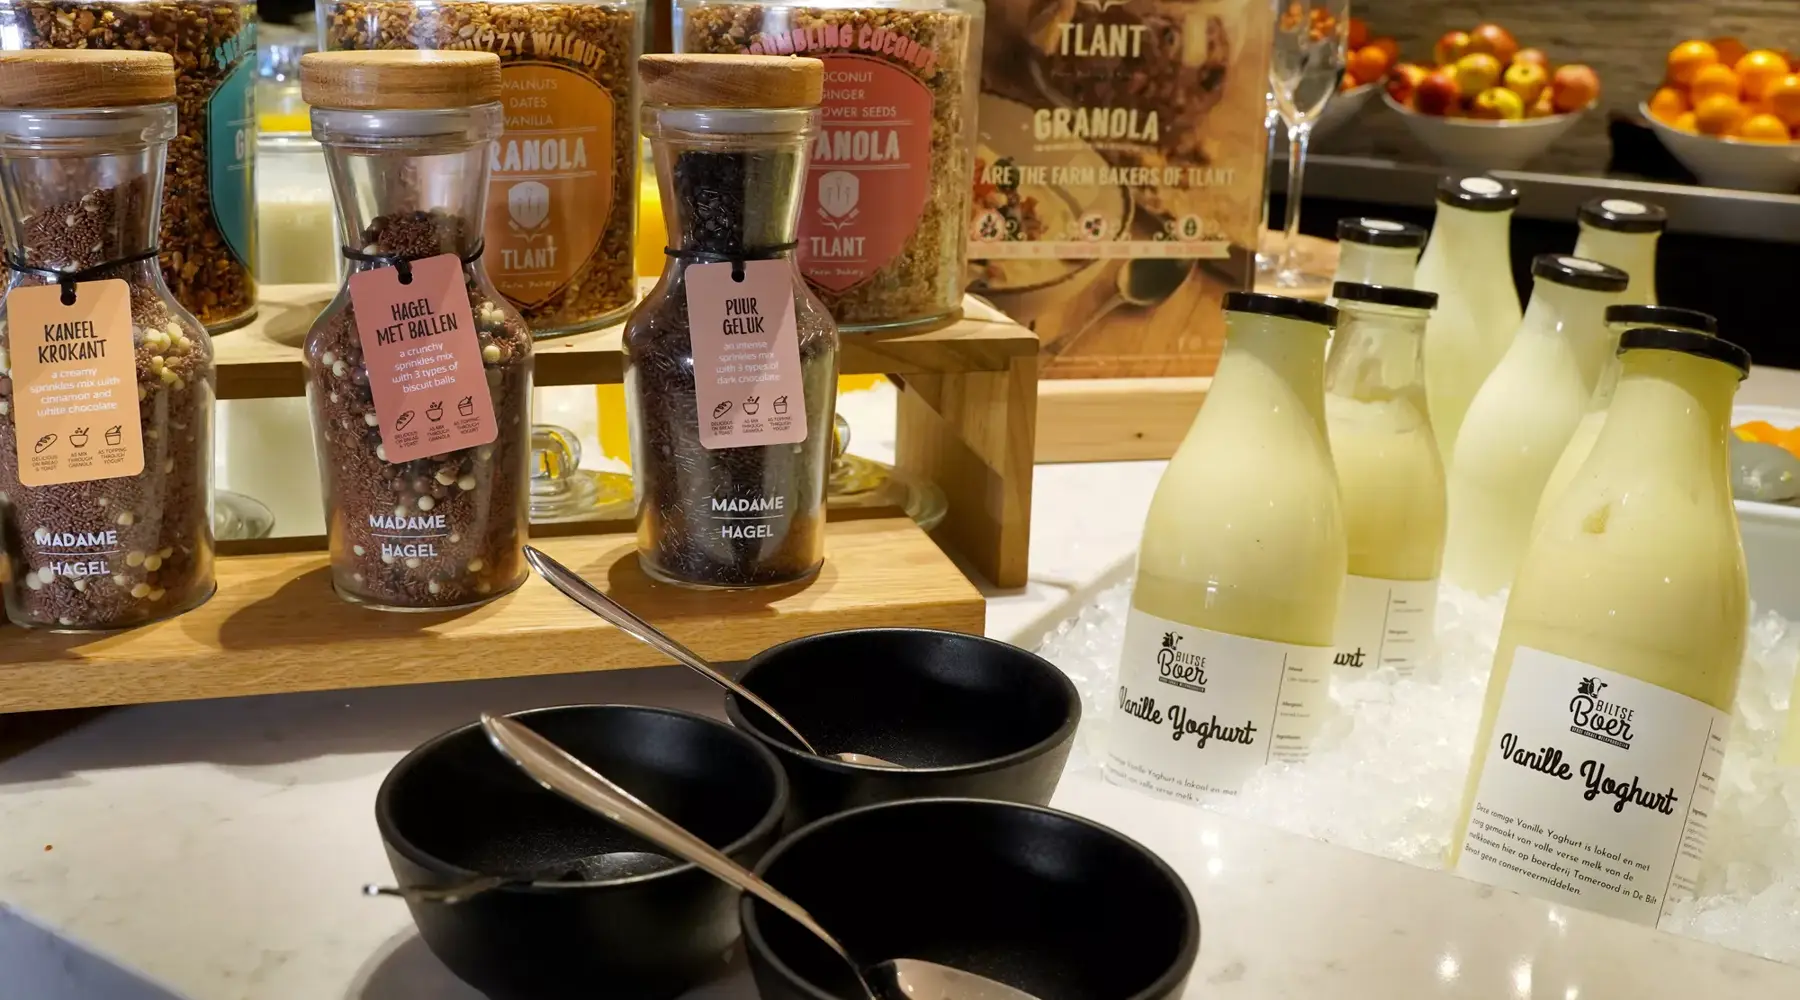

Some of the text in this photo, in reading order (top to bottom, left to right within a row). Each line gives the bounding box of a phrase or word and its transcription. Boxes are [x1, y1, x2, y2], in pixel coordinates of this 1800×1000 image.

[1058, 23, 1148, 57] TLANT
[532, 31, 606, 70] WALNUT
[858, 23, 937, 78] COCONUT
[501, 78, 558, 90] WALNUTS
[823, 71, 873, 82] OCONUT
[510, 97, 548, 108] DATES
[862, 106, 897, 116] SEEDS
[503, 114, 554, 127] VANILLA
[1034, 106, 1159, 142] GRANOLA
[489, 137, 587, 171] RANOLA
[981, 166, 1235, 186] ARE THE FARM BAKERS OF TLANT
[810, 236, 866, 257] TLANT
[501, 247, 558, 270] TLANT
[391, 298, 434, 321] HAGEL
[725, 297, 759, 316] PUUR
[44, 320, 98, 342] KANEEL
[376, 313, 458, 346] MET BALLEN
[723, 316, 765, 335] GELUK
[38, 339, 107, 364] KROKANT
[407, 342, 444, 356] crunchy
[723, 341, 768, 351] an intense
[395, 352, 454, 371] sprinkles mix
[718, 351, 775, 363] sprinkles mix
[51, 368, 98, 379] a creamy
[392, 362, 458, 383] with 3 types of
[716, 362, 779, 374] with 3 types of
[30, 377, 121, 394] sprinkles mix with
[402, 375, 456, 393] biscuit balls
[717, 372, 781, 385] dark chocolate
[41, 389, 112, 403] cinnamon and
[37, 402, 118, 417] white chocolate
[712, 496, 784, 512] MADAME
[369, 514, 447, 530] MADAME
[722, 525, 774, 538] HAGEL
[37, 530, 118, 547] MADAME
[381, 543, 438, 557] HAGEL
[49, 561, 110, 575] HAGEL
[1157, 648, 1208, 685] Boer
[1176, 651, 1206, 668] BILTSE
[1119, 686, 1257, 749] Vanille Yoghurt
[1569, 695, 1634, 741] Boer
[1596, 700, 1634, 722] BILTSE
[1500, 732, 1573, 780] Vanille
[1579, 759, 1679, 815] Yoghurt
[1476, 802, 1651, 872] Deze romige Vanille Yoghurt is lokaal en met
[1472, 818, 1634, 881] zorg gemaakt van volle verse melk van de
[1465, 843, 1583, 896] Bevat geen conserveermiddelen.
[1469, 831, 1501, 849] melkkoeien
[1502, 843, 1517, 855] hier
[1518, 852, 1529, 862] op
[1531, 854, 1571, 876] boerderij
[1573, 869, 1622, 893] Tameroord
[1622, 888, 1630, 896] in
[1632, 890, 1643, 901] De
[1645, 894, 1657, 904] Bilt
